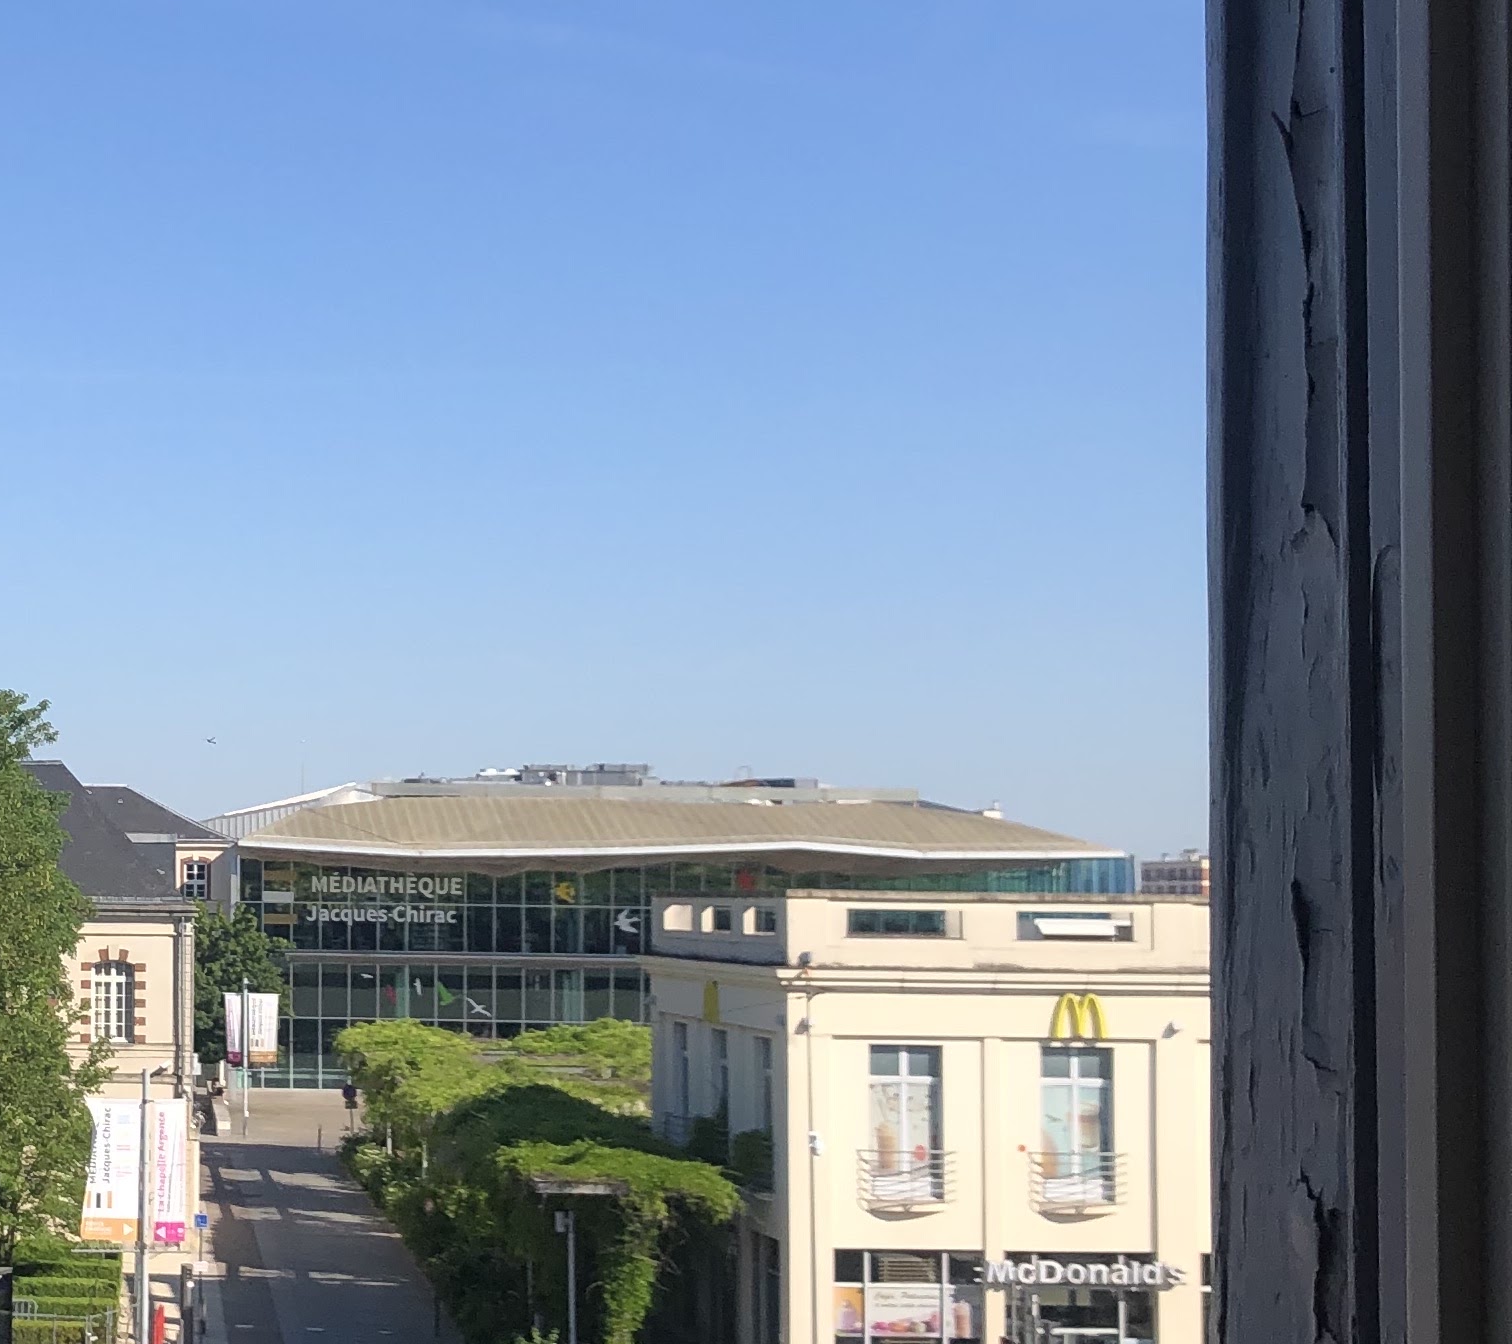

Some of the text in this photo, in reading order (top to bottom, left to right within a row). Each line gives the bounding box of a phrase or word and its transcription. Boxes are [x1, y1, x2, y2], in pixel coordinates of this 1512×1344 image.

[311, 872, 462, 898] MÉDIATHÈQUE
[306, 906, 457, 926] Jacques-Chirac
[101, 1107, 112, 1184] Jacques-Chirac
